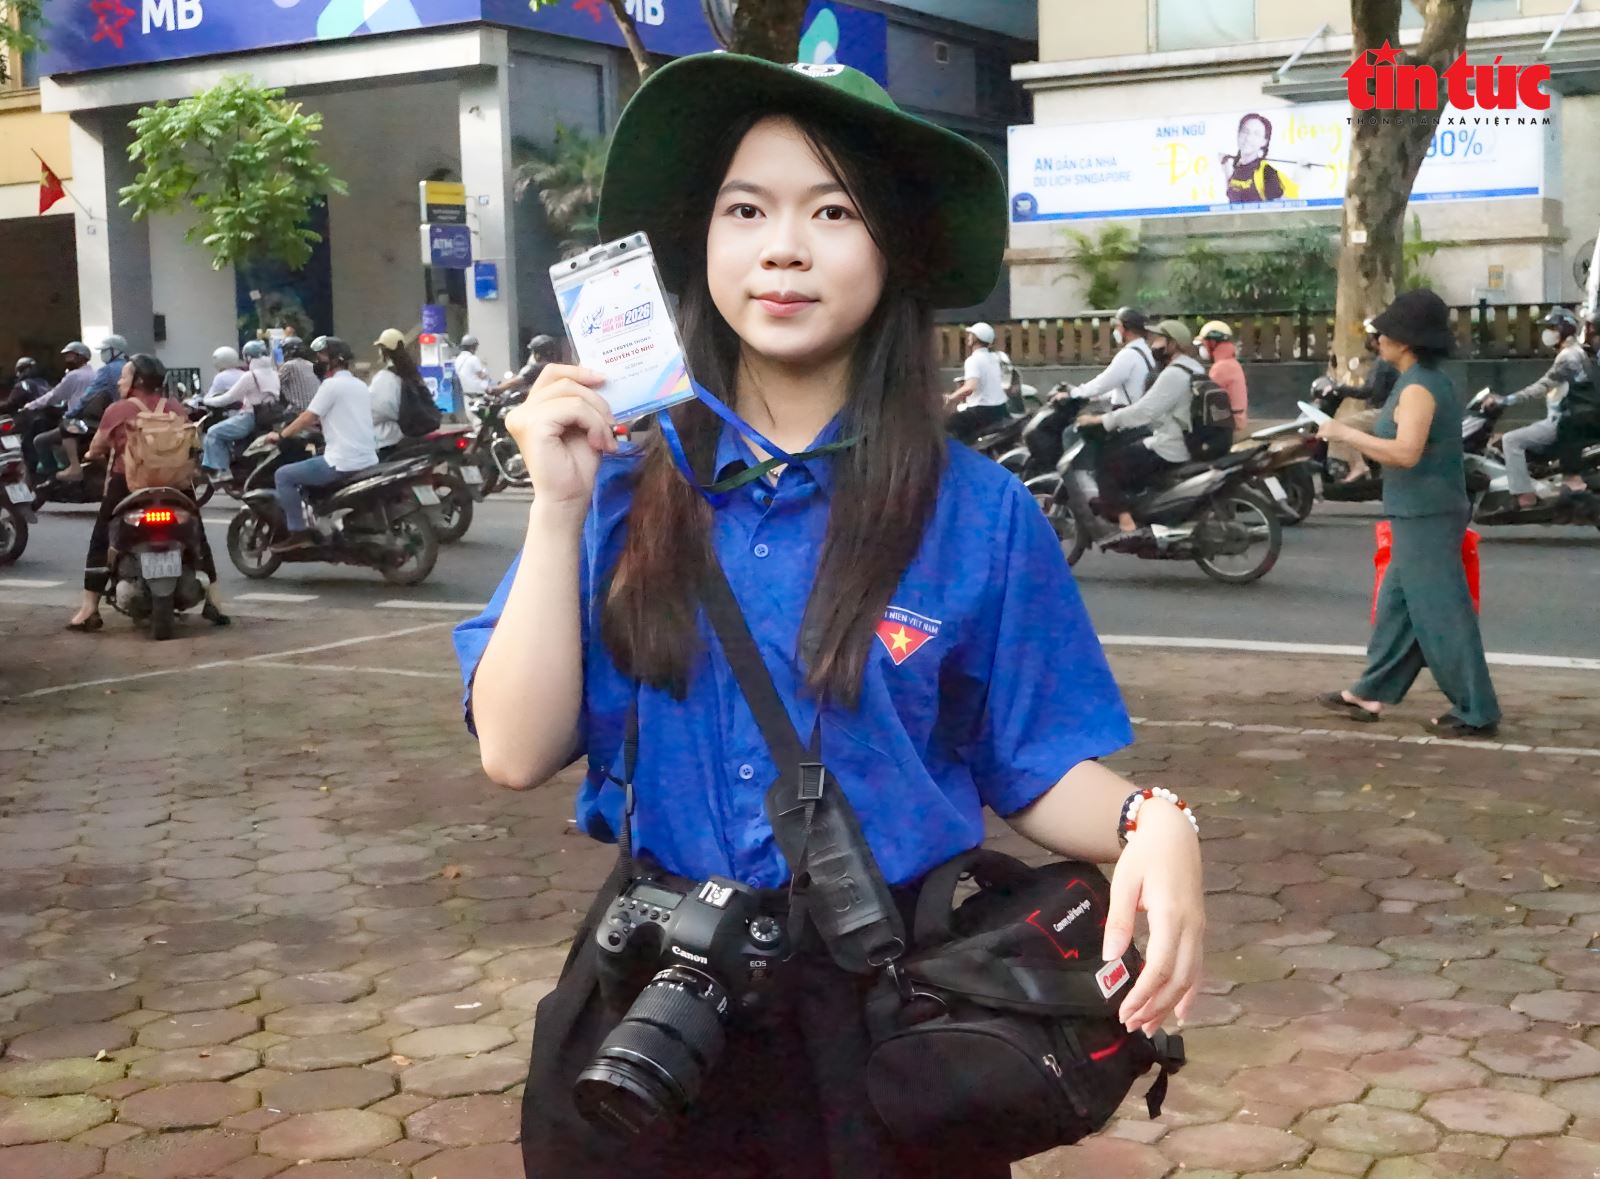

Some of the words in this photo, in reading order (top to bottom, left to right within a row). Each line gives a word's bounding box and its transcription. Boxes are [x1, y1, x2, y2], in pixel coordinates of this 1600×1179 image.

[142, 0, 203, 34] MB
[625, 304, 649, 325] 2026
[672, 945, 708, 965] Canon
[749, 960, 767, 968] EOS
